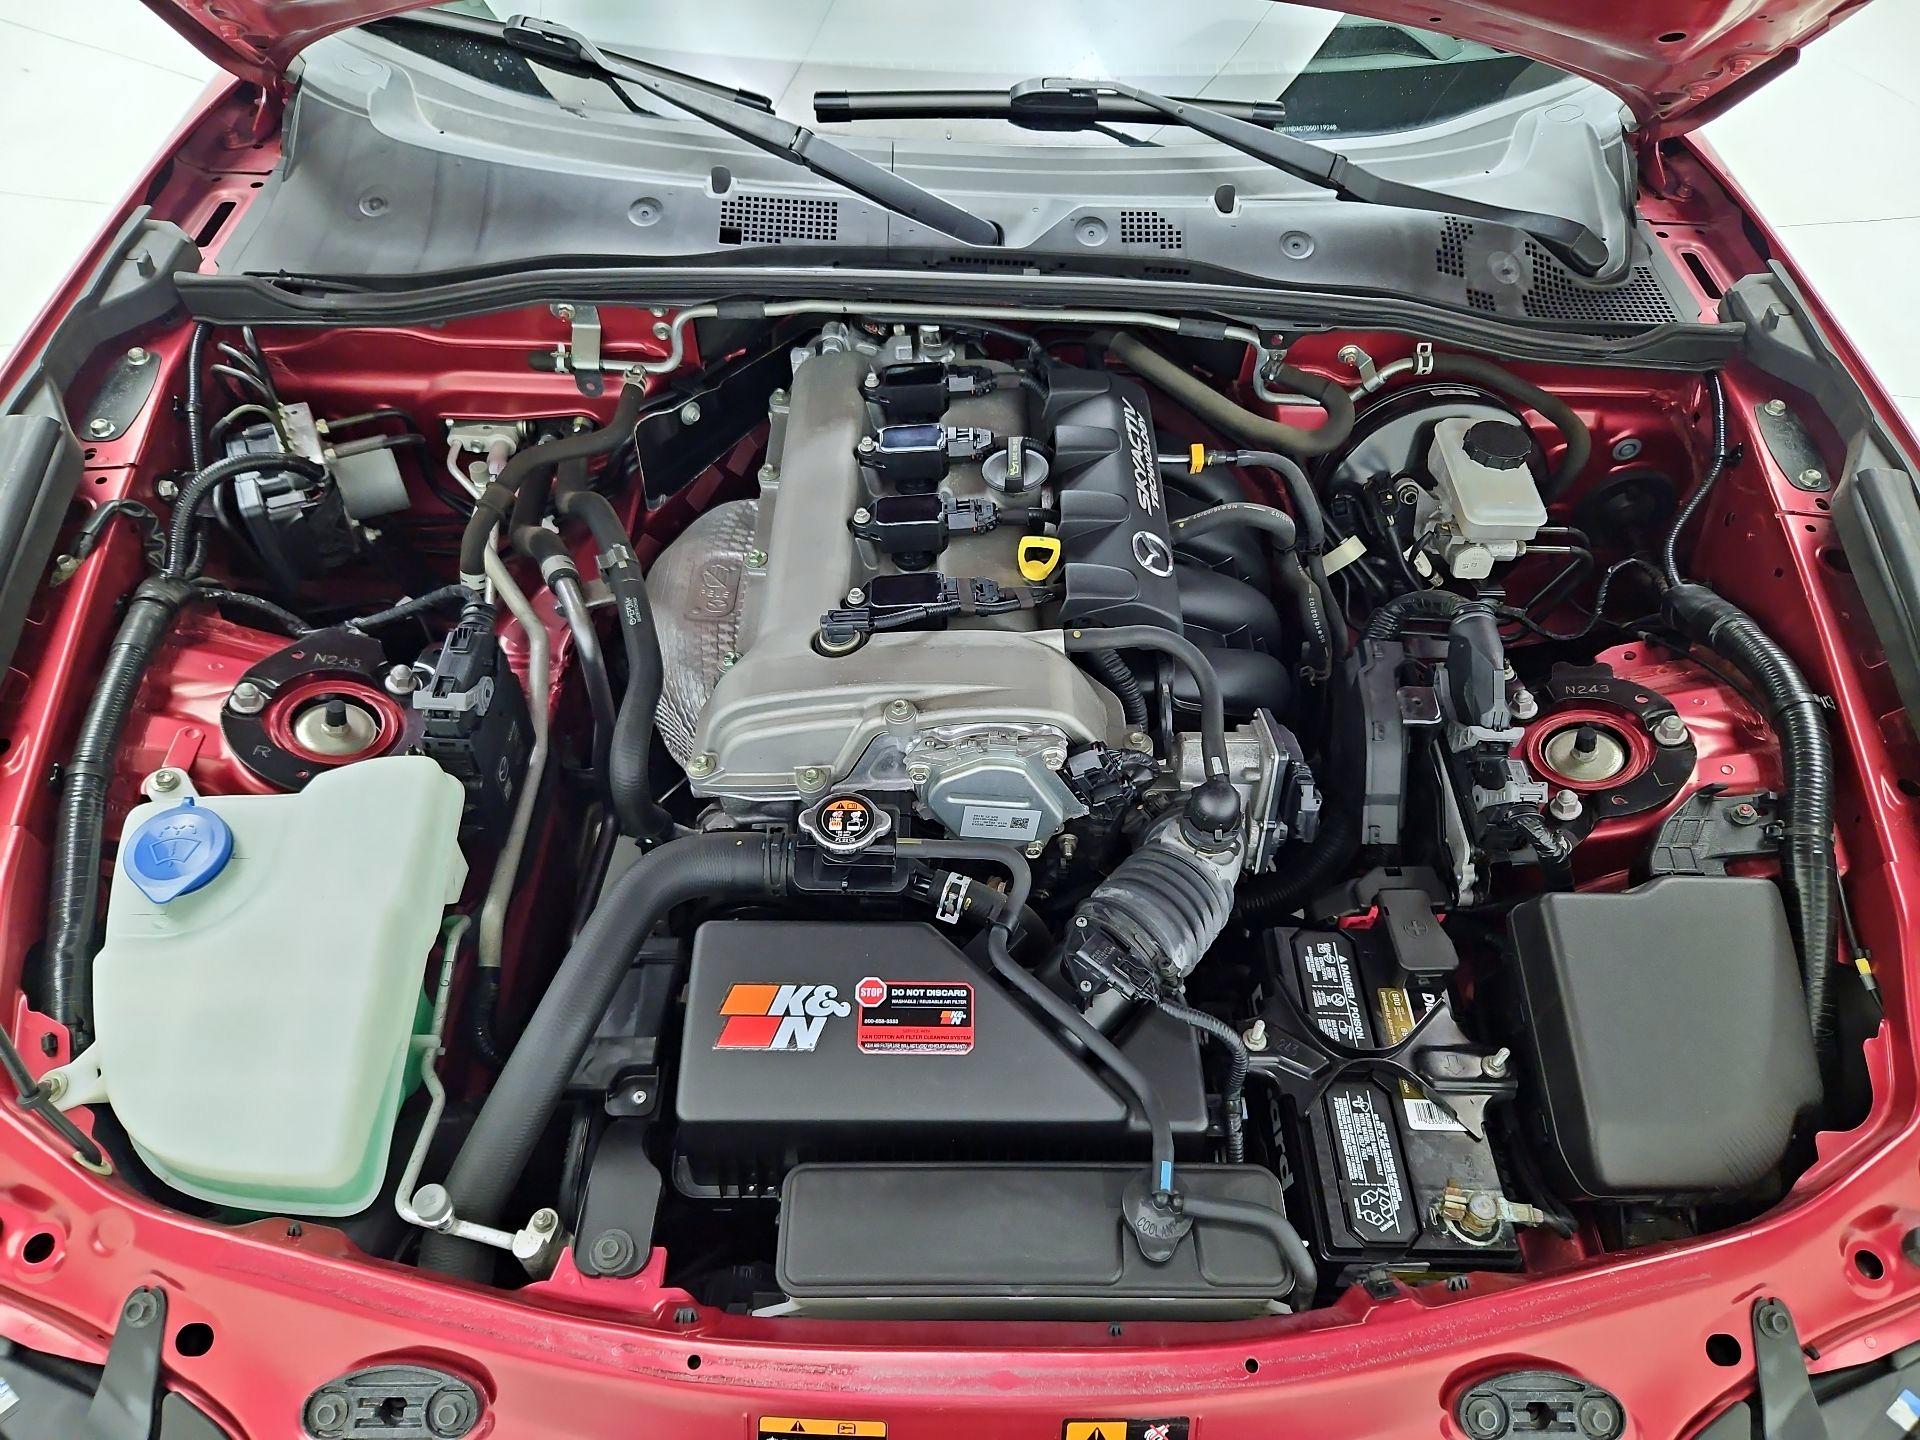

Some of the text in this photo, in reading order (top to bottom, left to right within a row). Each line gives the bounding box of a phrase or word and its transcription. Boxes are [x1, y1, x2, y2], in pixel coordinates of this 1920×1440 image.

[1121, 396, 1152, 517] SKYACTIV
[1137, 411, 1160, 510] TECHNOLOGY
[314, 652, 361, 668] N243
[1565, 684, 1610, 695] N243
[252, 745, 272, 758] R
[861, 988, 882, 997] STOP
